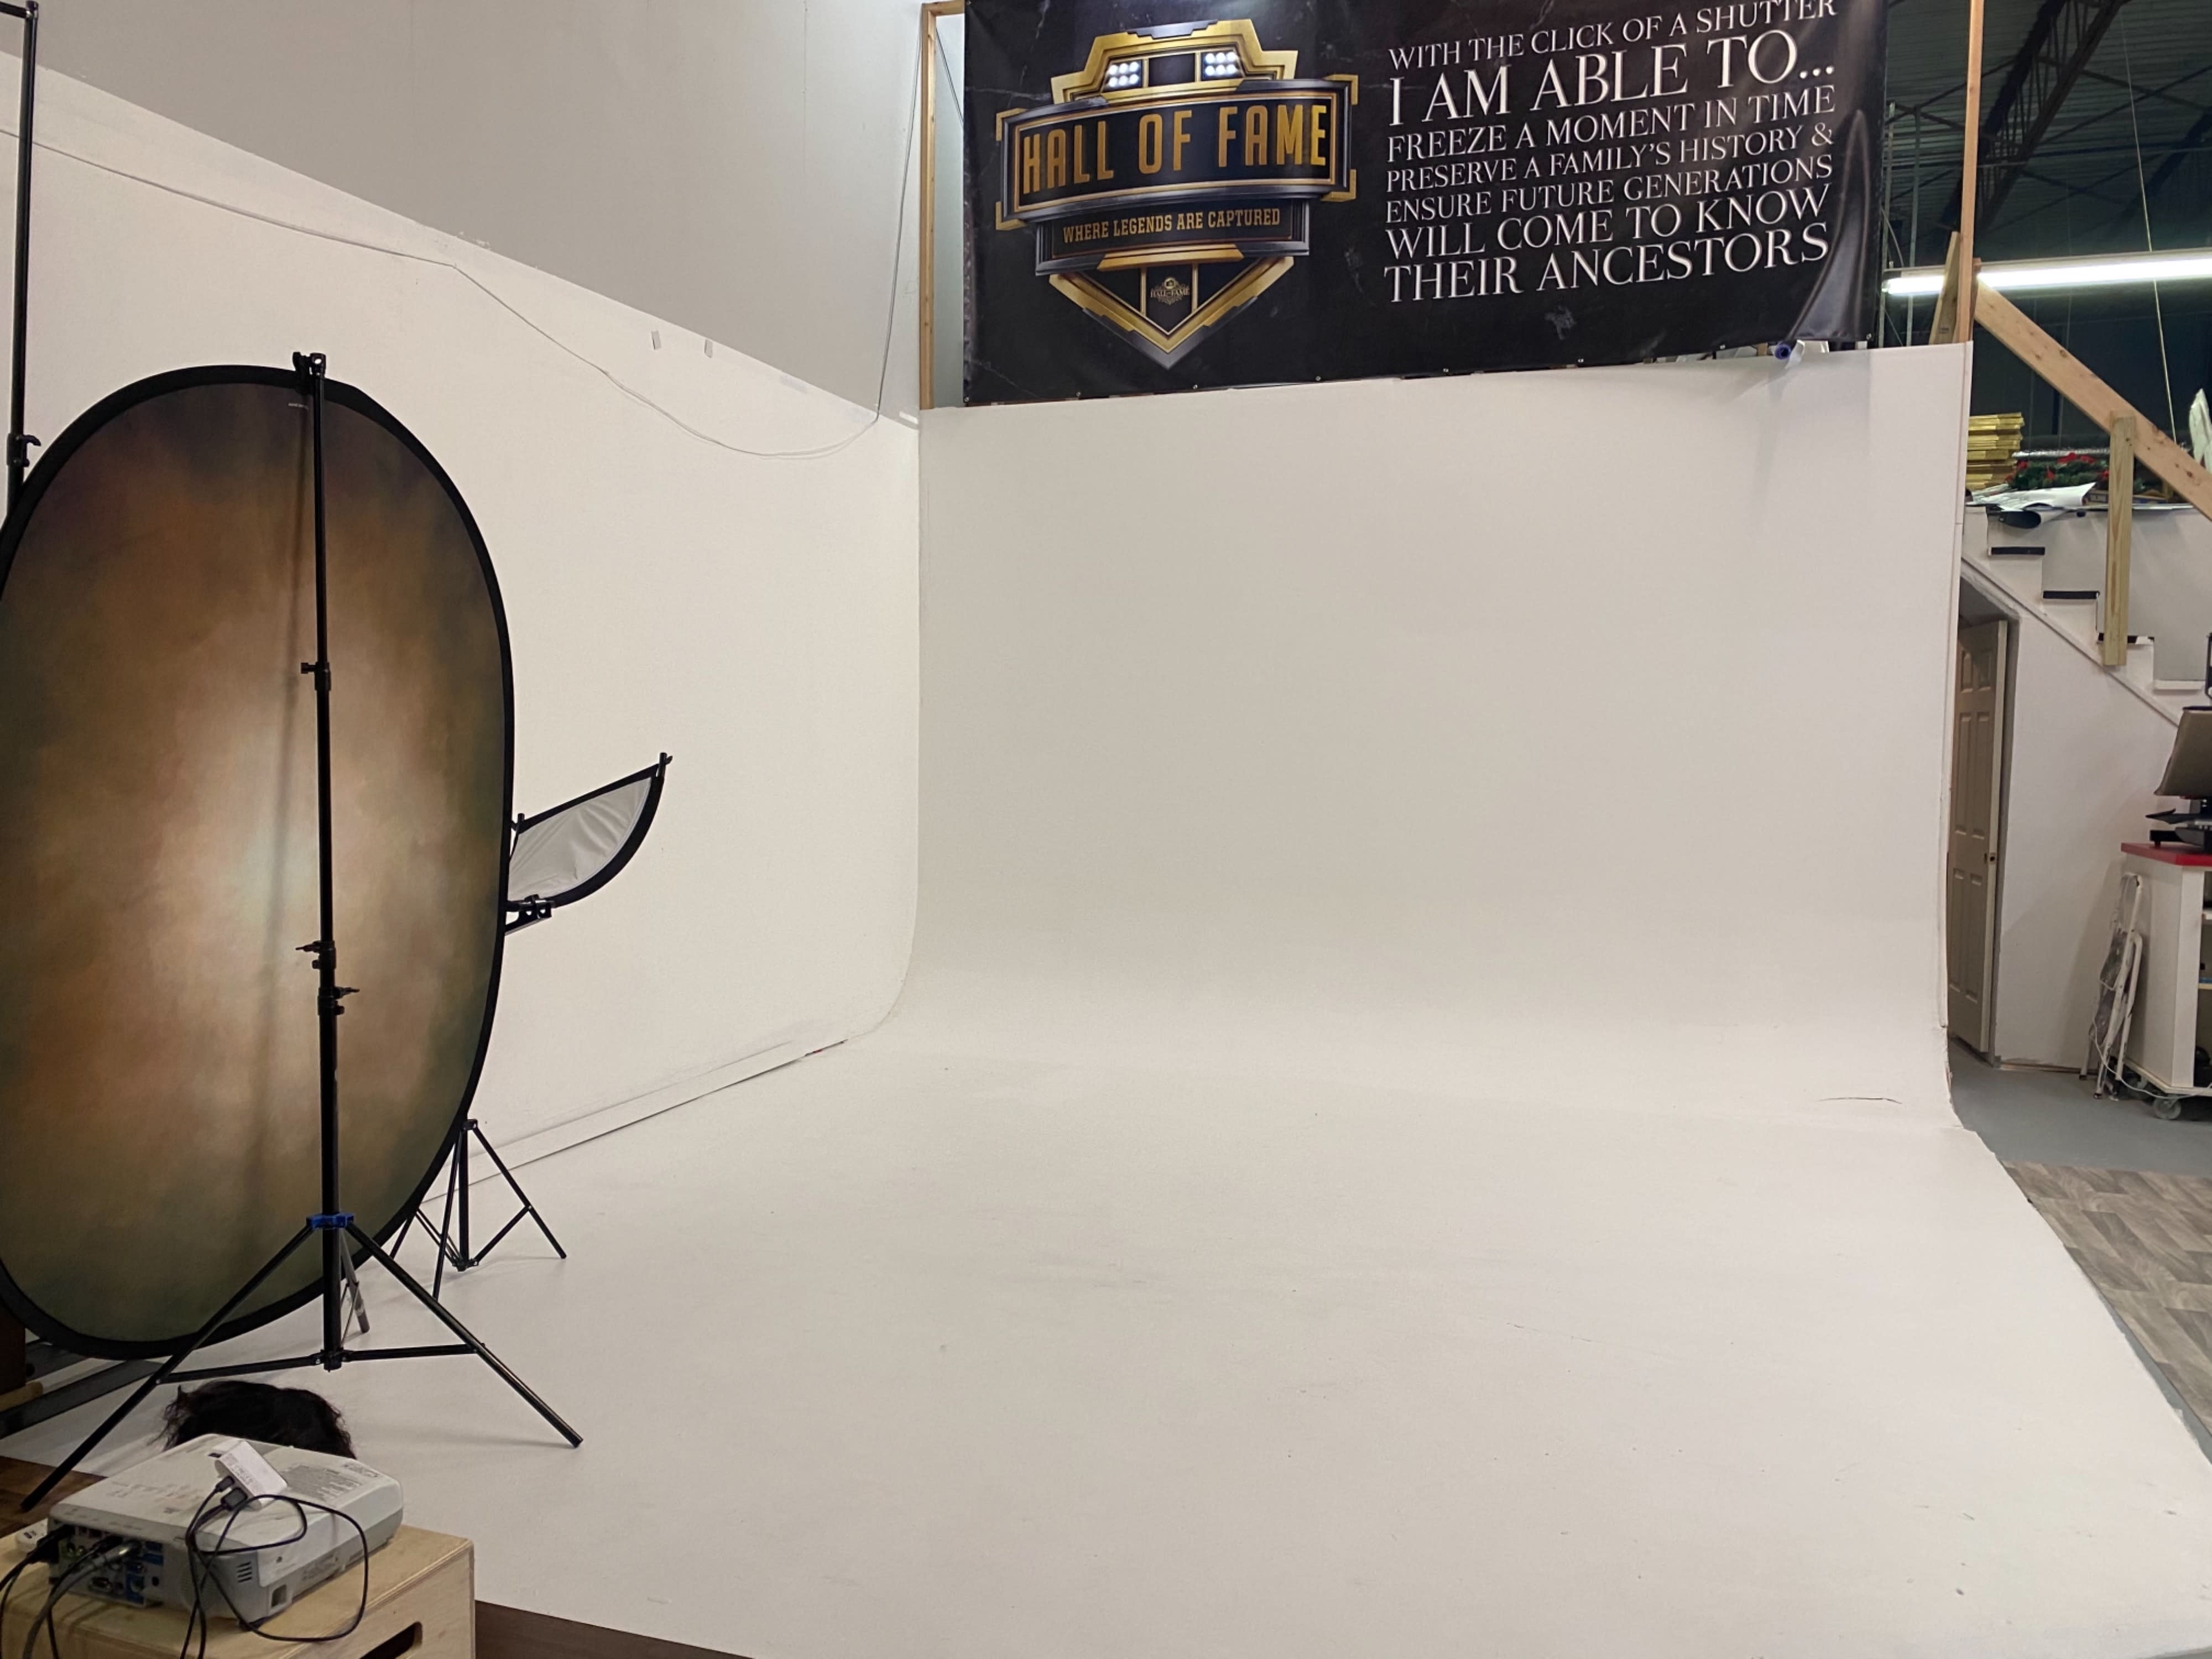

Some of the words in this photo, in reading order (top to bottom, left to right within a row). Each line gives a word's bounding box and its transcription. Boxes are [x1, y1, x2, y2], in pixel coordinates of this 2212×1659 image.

[1388, 41, 1460, 70] WITH
[1468, 33, 1524, 61] THE
[1531, 22, 1614, 54] CLICK
[1623, 15, 1662, 42] OF
[1669, 13, 1687, 36] A
[1696, 0, 1838, 33] SHUTTER
[1389, 77, 1404, 126] I
[1421, 65, 1511, 122] AM
[1529, 43, 1688, 111] ABLE
[1707, 29, 1835, 88] TO...
[1023, 120, 1114, 195] HALL
[1138, 109, 1193, 175] OF
[1218, 103, 1328, 168] FAME
[1386, 158, 1517, 192] PRESERVE
[1524, 156, 1541, 179] A
[1550, 142, 1671, 176] FAMILY'S
[1679, 124, 1802, 163] HISTORY
[1811, 122, 1833, 147] &
[1387, 124, 1506, 163] FREEZE
[1515, 122, 1536, 149] A
[1546, 103, 1695, 147] MOMENT
[1704, 97, 1736, 128] IN
[1747, 84, 1835, 123] TIME
[1062, 225, 1109, 244] WHERE
[1113, 214, 1173, 237] LEGENDS
[1176, 211, 1204, 230] ARE
[1207, 207, 1280, 229] CAPTURED
[1385, 222, 1485, 259] WILL
[1497, 209, 1614, 251] COME
[1625, 204, 1682, 239] TO
[1696, 183, 1830, 233] KNOW
[1386, 191, 1492, 223] ENSURE
[1501, 179, 1614, 212] FUTURE
[1624, 154, 1833, 201] GENERATIONS
[1384, 256, 1524, 302] THEIR
[1536, 222, 1828, 291] ANCESTORS
